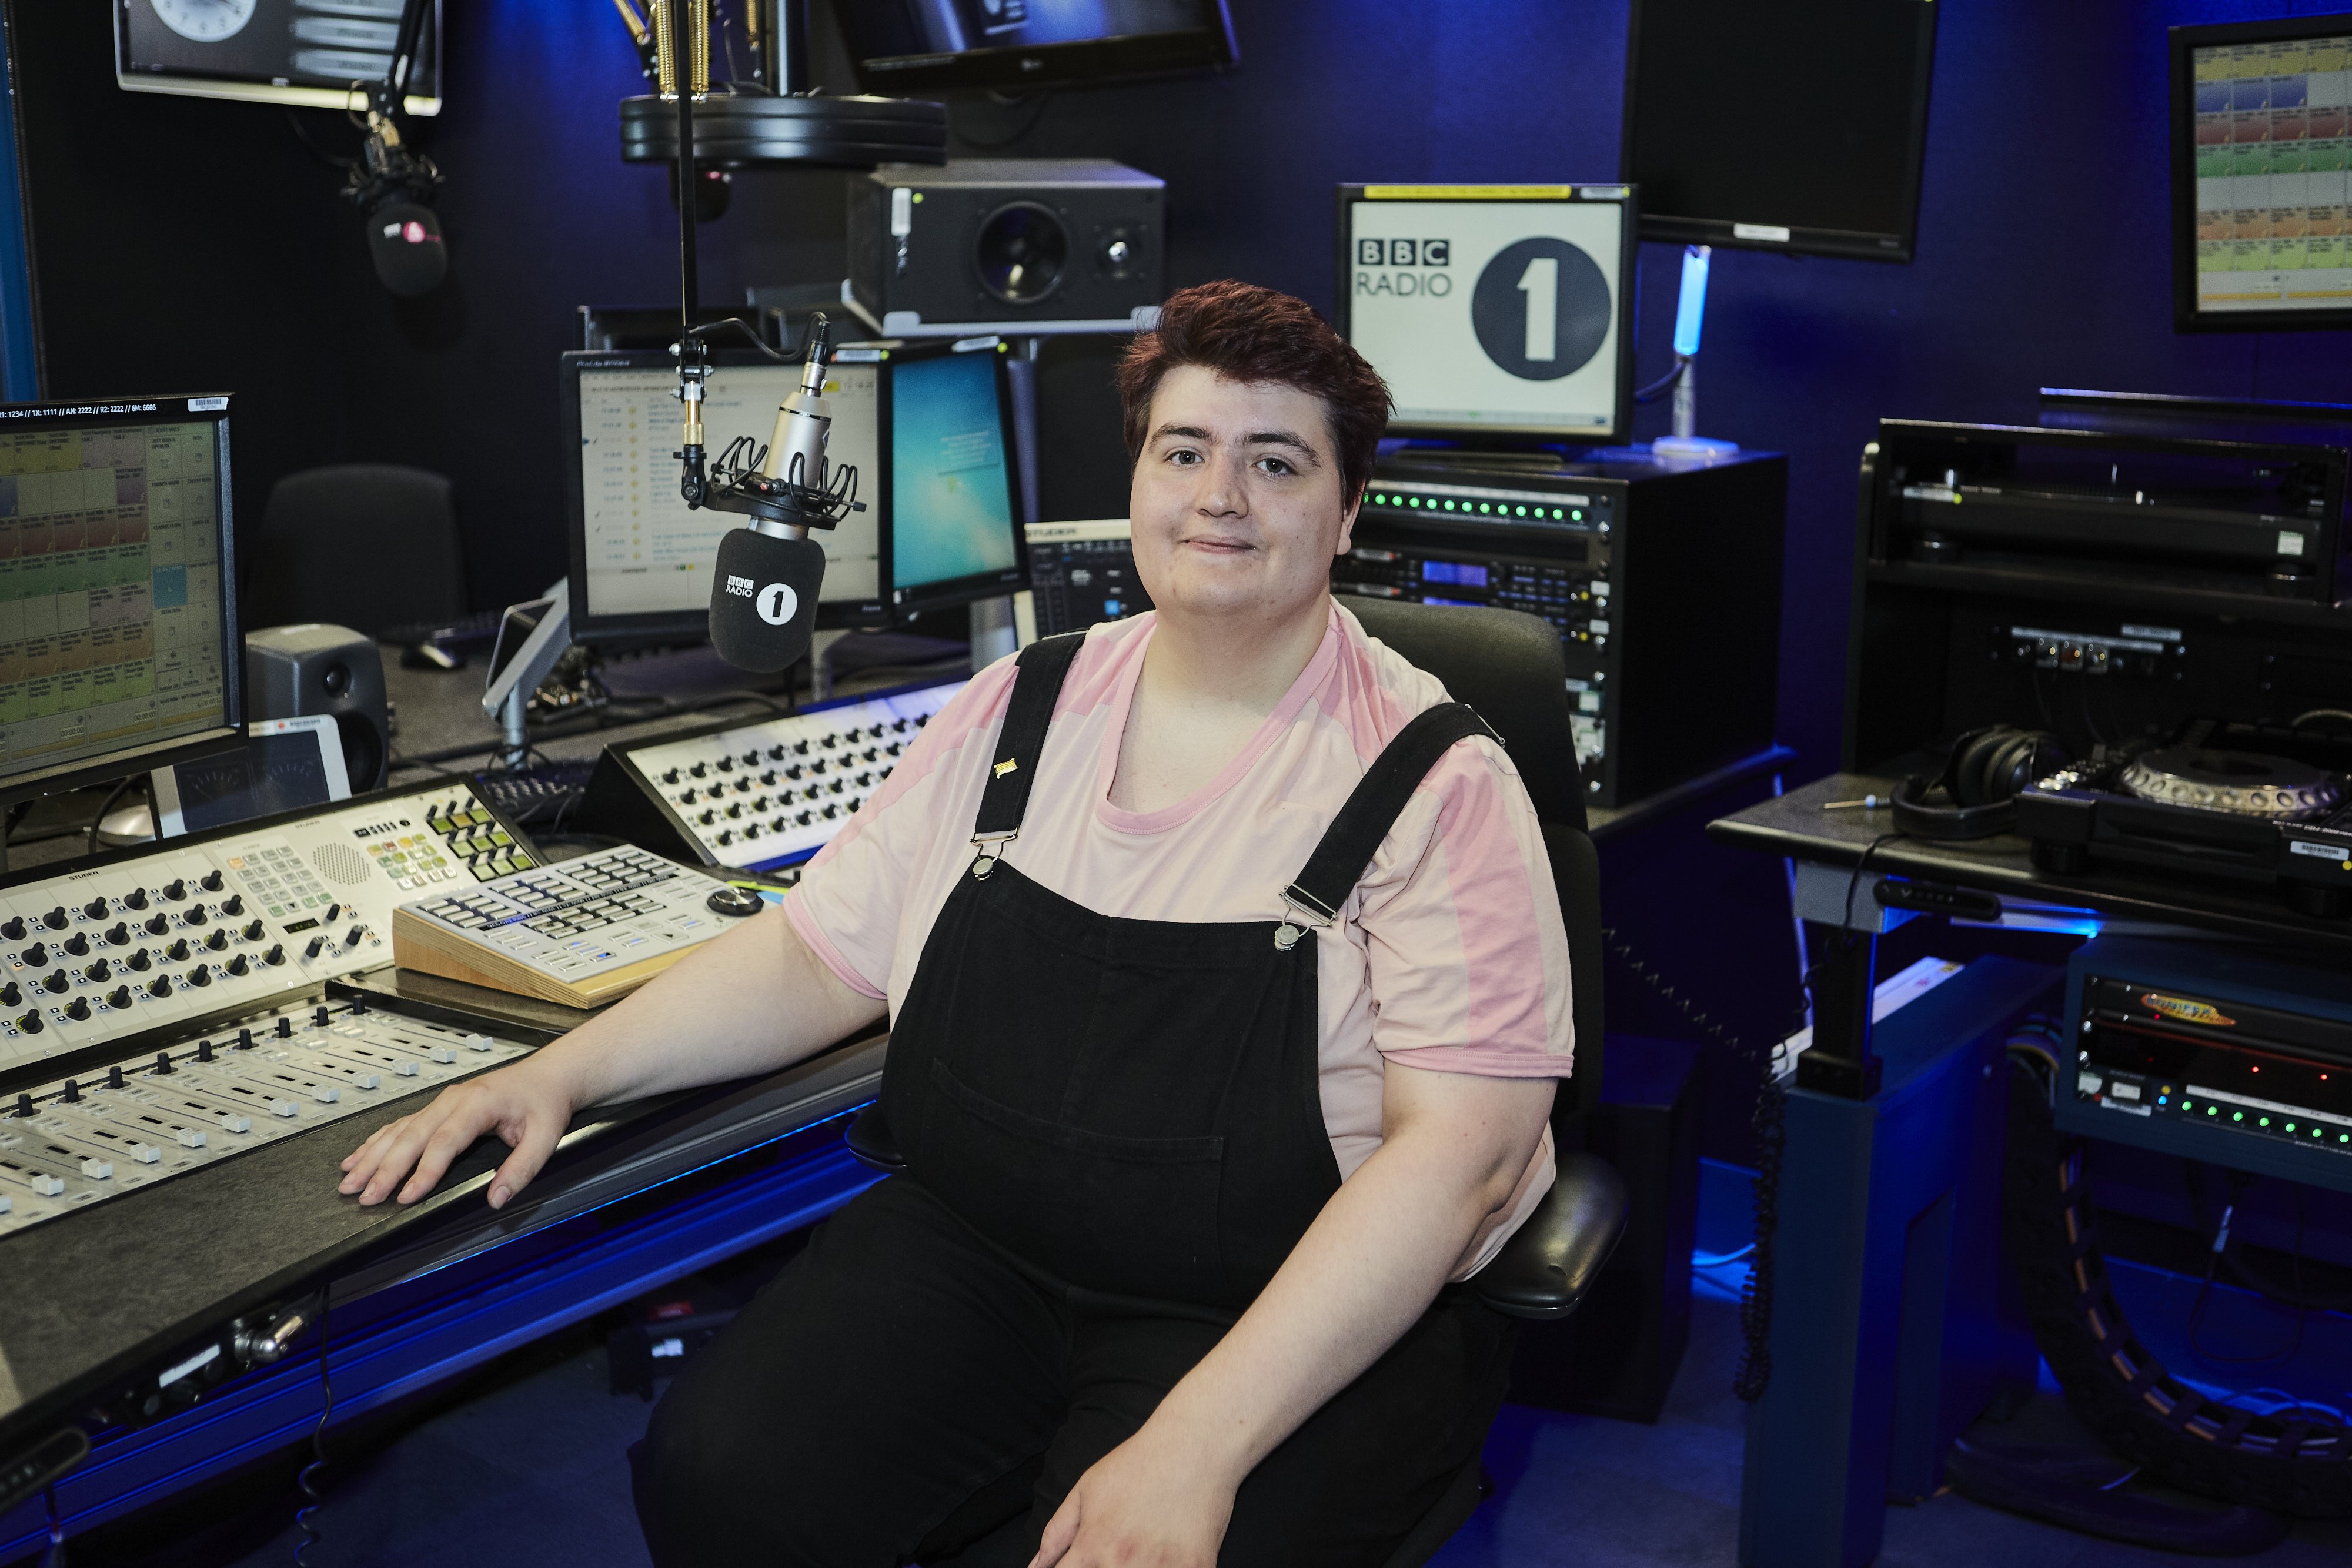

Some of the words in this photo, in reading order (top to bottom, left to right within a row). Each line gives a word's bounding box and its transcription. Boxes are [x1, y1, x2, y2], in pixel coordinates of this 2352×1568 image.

[1359, 240, 1449, 266] BBC
[1356, 272, 1453, 297] RADIO
[1517, 258, 1558, 361] 1
[66, 407, 77, 415] AN:
[78, 406, 92, 414] 2222
[110, 405, 124, 413] 2222
[726, 584, 753, 598] RADIO
[727, 574, 754, 590] BBC
[773, 590, 784, 618] 1
[69, 870, 99, 881] STUDER
